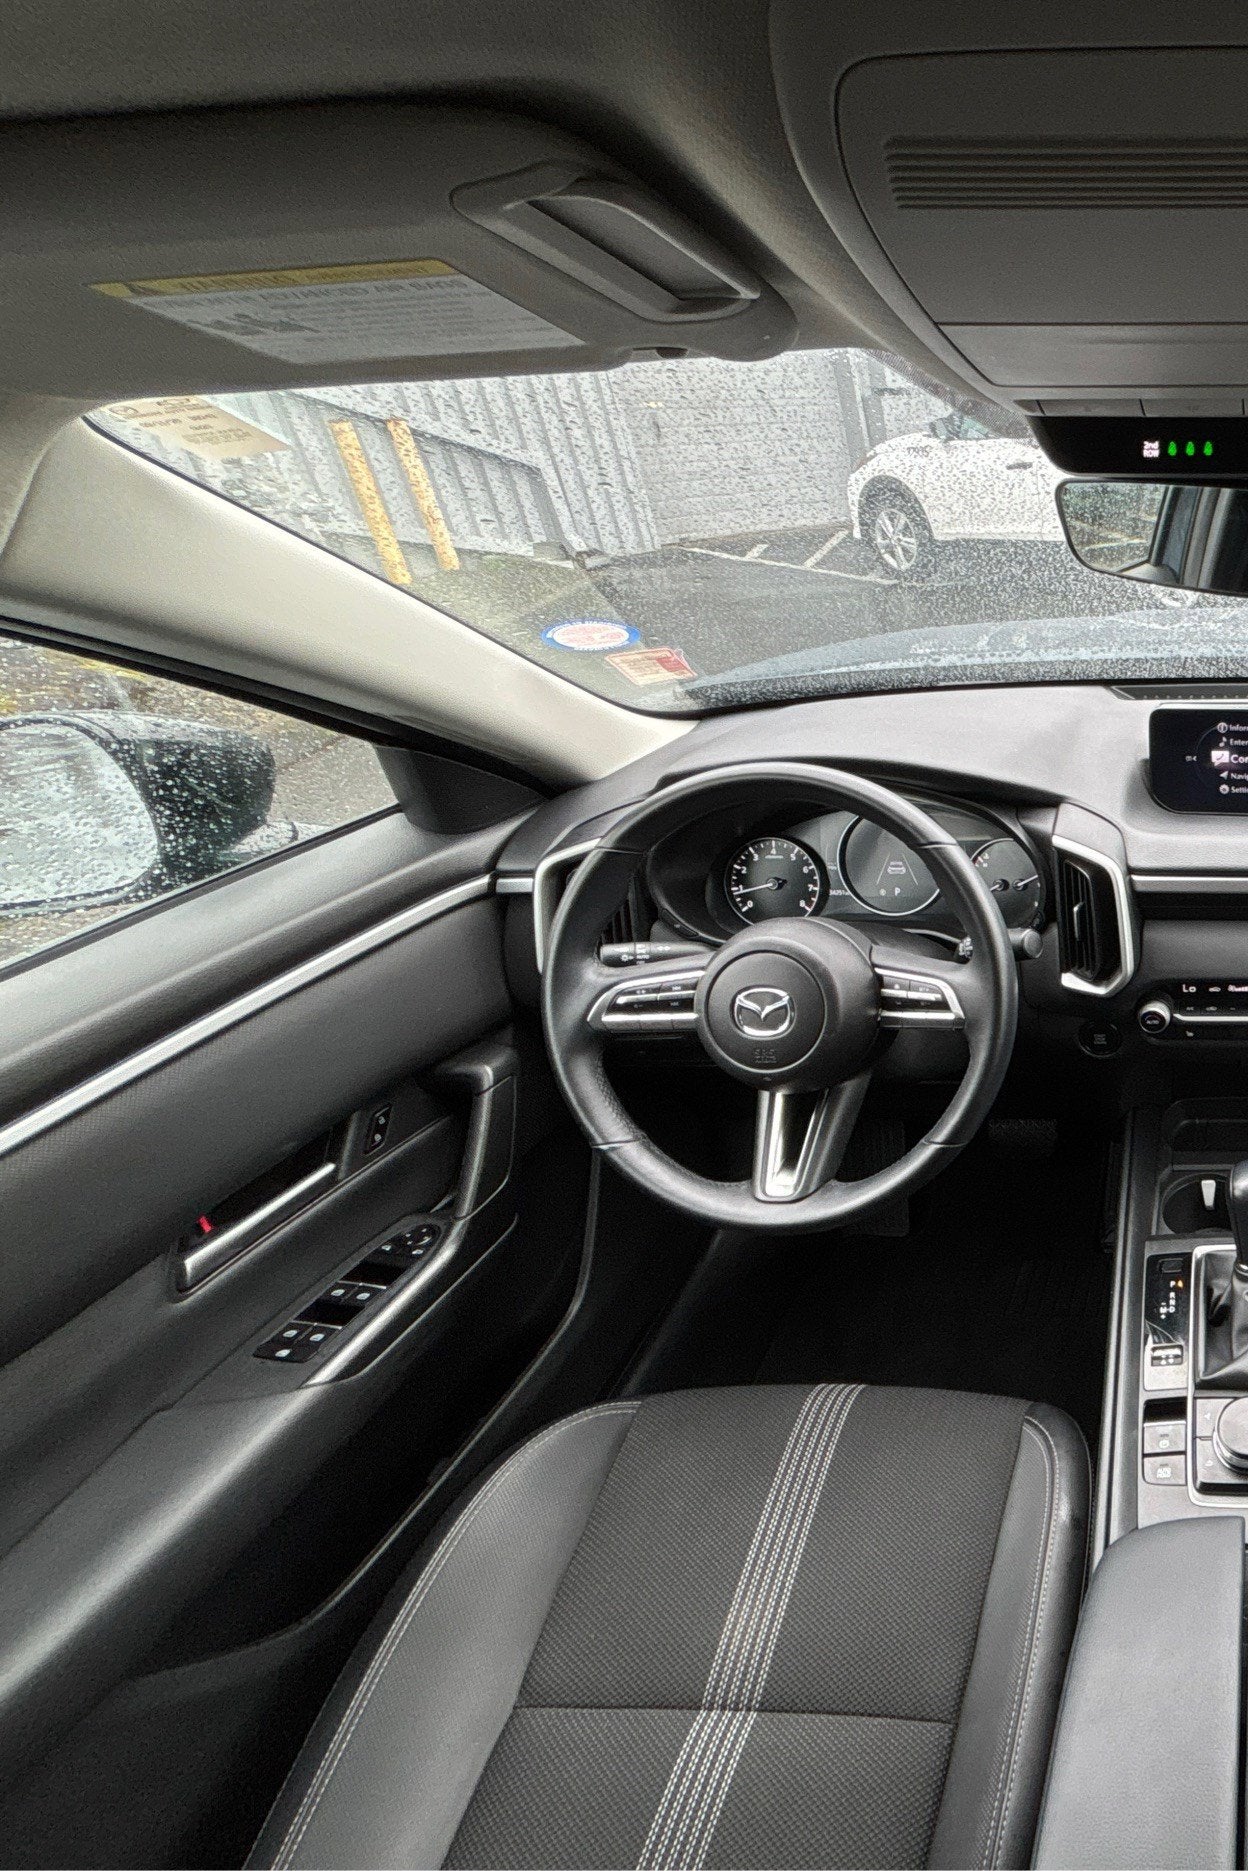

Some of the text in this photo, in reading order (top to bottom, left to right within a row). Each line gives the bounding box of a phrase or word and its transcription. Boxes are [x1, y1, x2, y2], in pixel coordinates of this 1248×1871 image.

[1143, 440, 1160, 449] 2nd
[1143, 449, 1160, 458] ROW
[741, 866, 747, 874] 2
[802, 866, 809, 874] 6
[894, 887, 901, 896] P
[746, 900, 754, 908] 0
[799, 899, 806, 907] 8
[1182, 984, 1197, 993] Lo
[1170, 1280, 1176, 1288] P
[1169, 1291, 1176, 1299] R
